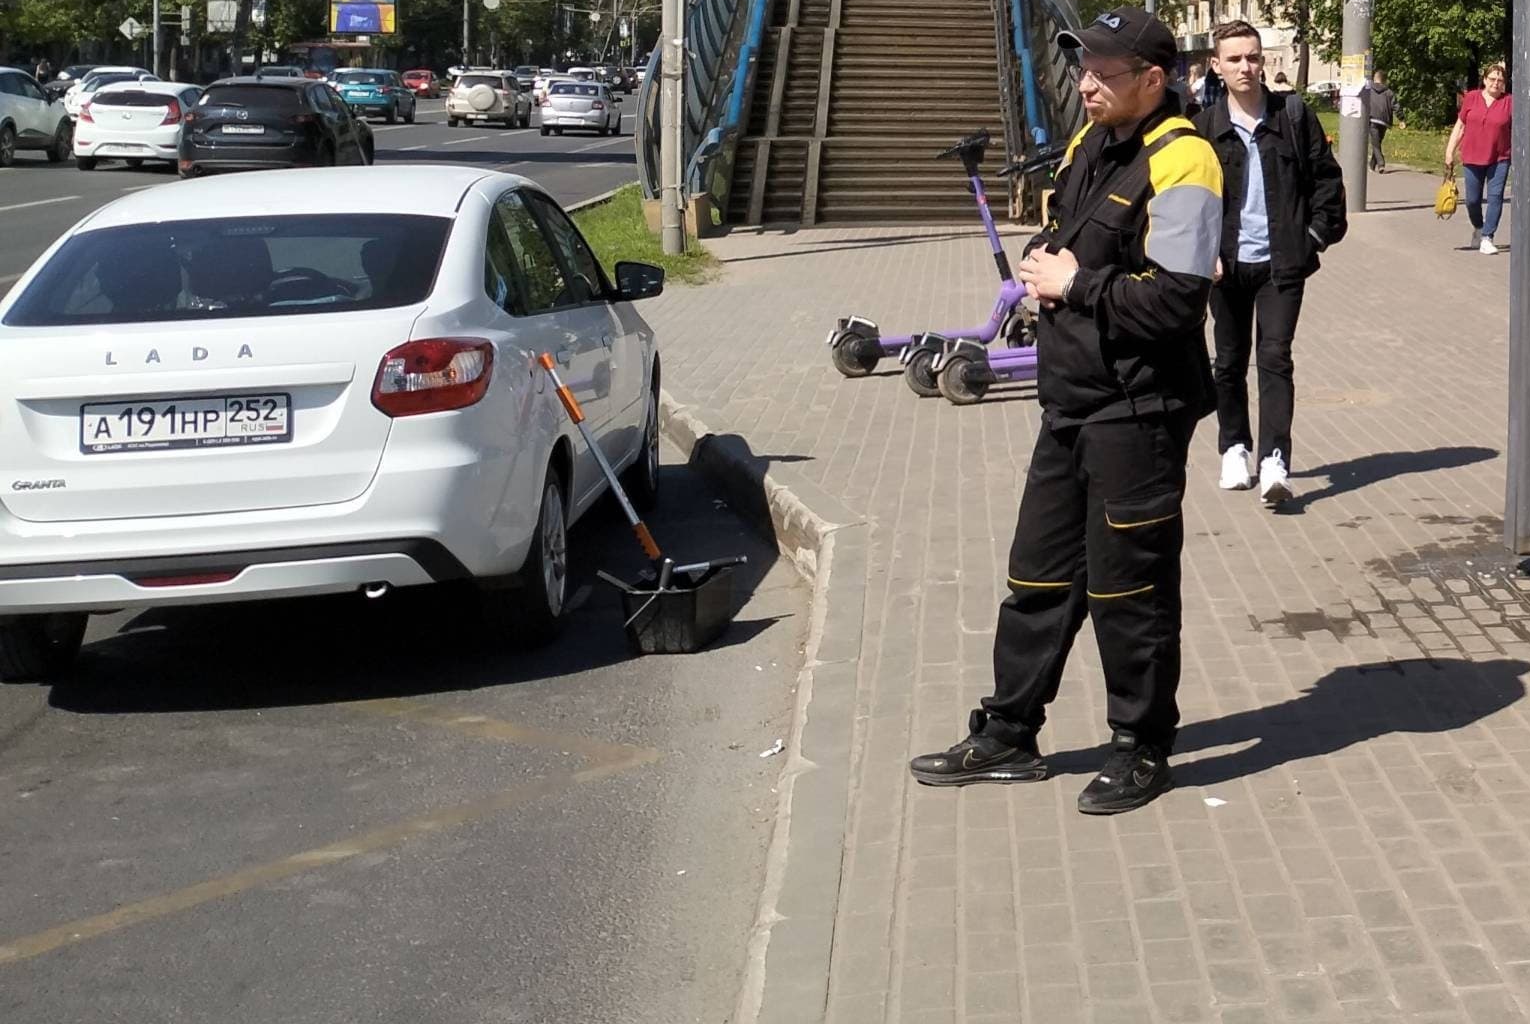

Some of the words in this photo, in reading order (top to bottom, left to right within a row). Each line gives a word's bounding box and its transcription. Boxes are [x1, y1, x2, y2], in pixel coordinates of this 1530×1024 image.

[105, 343, 253, 366] LADA
[228, 398, 278, 423] 252
[240, 423, 265, 432] RUS
[12, 479, 66, 491] GRANTA
